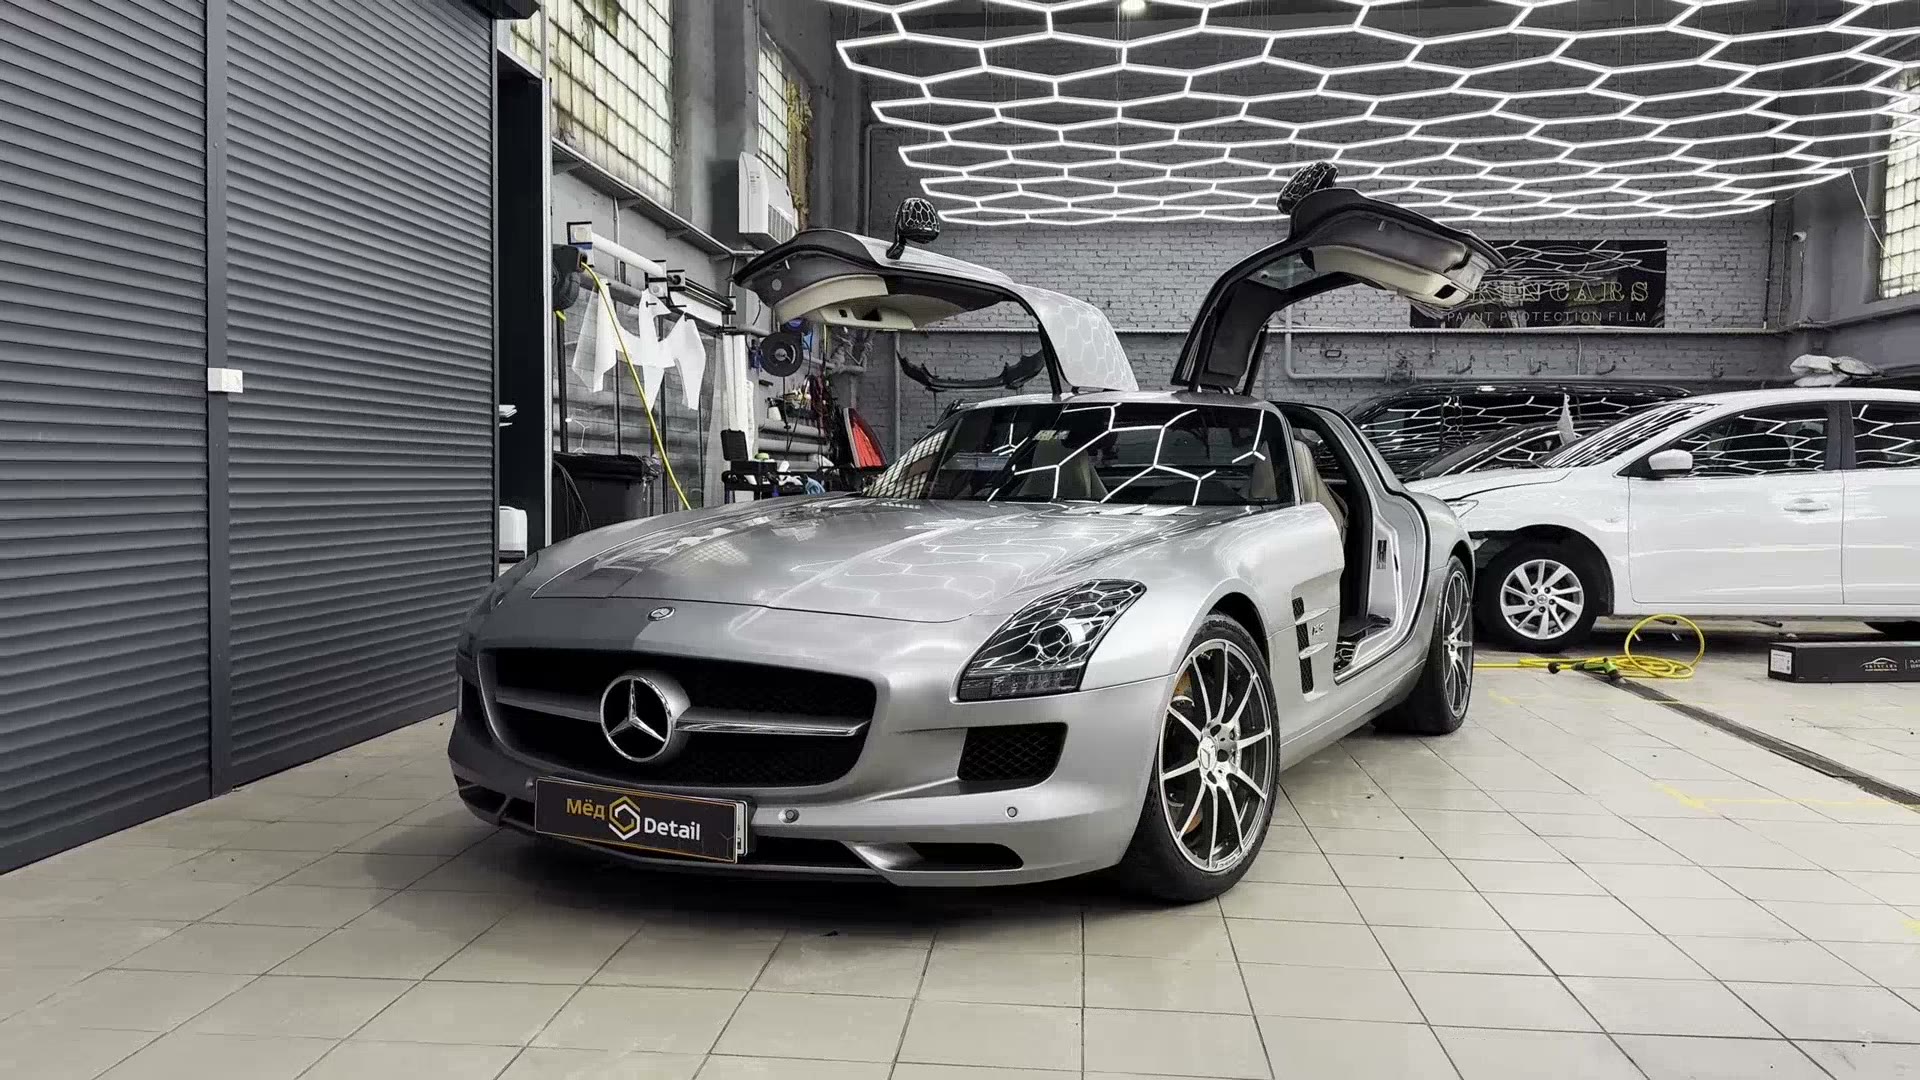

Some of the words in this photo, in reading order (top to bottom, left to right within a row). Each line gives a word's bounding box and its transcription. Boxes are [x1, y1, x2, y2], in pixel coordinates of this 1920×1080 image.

[1447, 311, 1493, 322] PAINT
[1500, 311, 1602, 322] PROTECTION
[1608, 311, 1646, 322] FILM
[566, 798, 606, 820] Мёд
[644, 817, 700, 841] Detail
